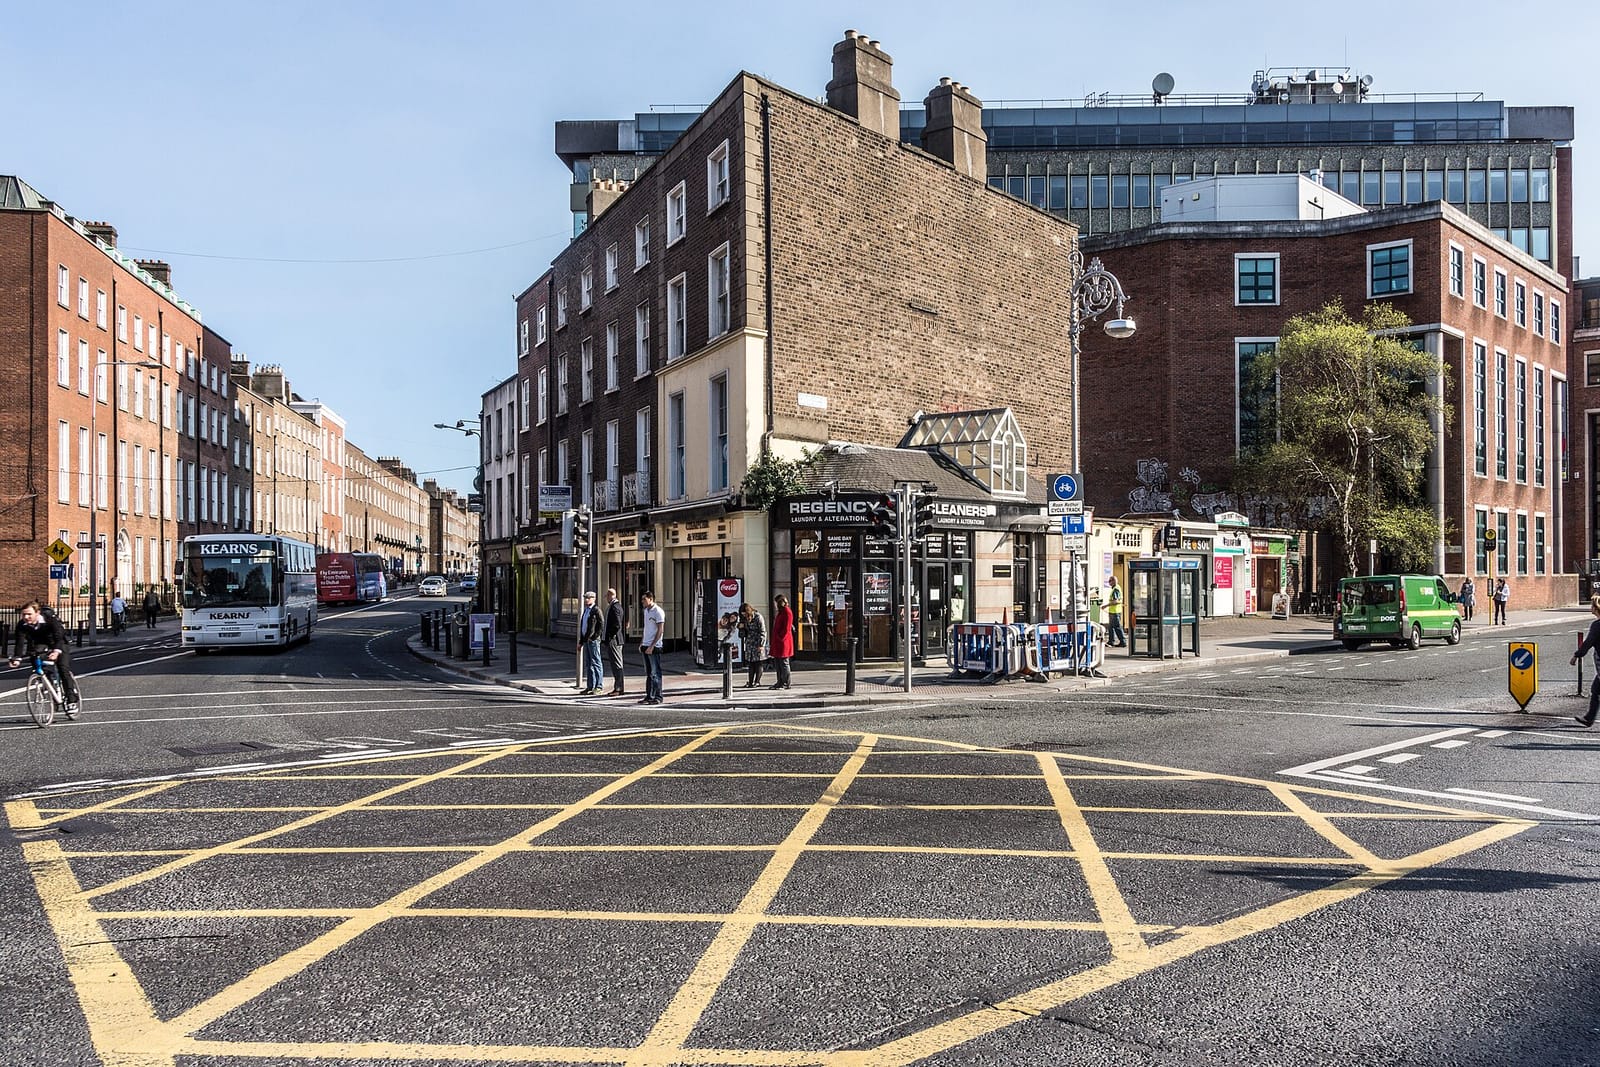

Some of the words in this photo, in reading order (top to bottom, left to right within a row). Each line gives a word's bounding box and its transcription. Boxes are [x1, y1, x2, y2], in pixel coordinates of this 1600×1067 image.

[789, 501, 880, 514] REGENCY
[1114, 532, 1140, 540] CHAPTER
[200, 543, 258, 555] KEARNS
[1197, 540, 1210, 550] SOL
[209, 611, 250, 620] KEARNS
